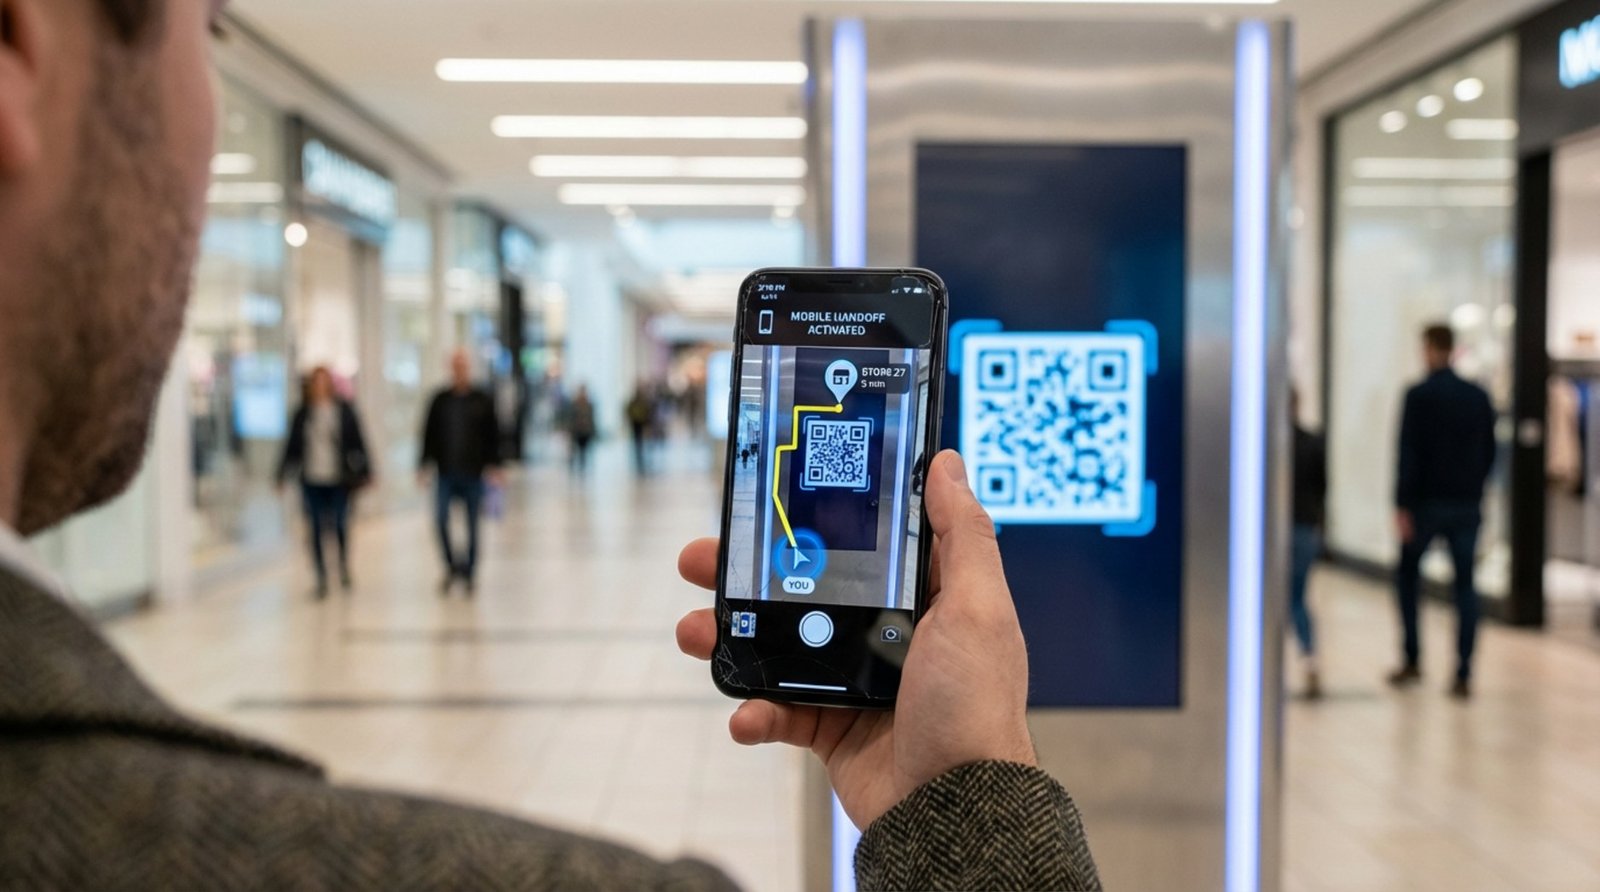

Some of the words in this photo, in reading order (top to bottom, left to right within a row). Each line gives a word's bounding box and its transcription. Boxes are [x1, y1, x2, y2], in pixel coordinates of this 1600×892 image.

[790, 311, 832, 322] MOBILE
[893, 367, 906, 377] 27
[788, 580, 809, 590] YOU
